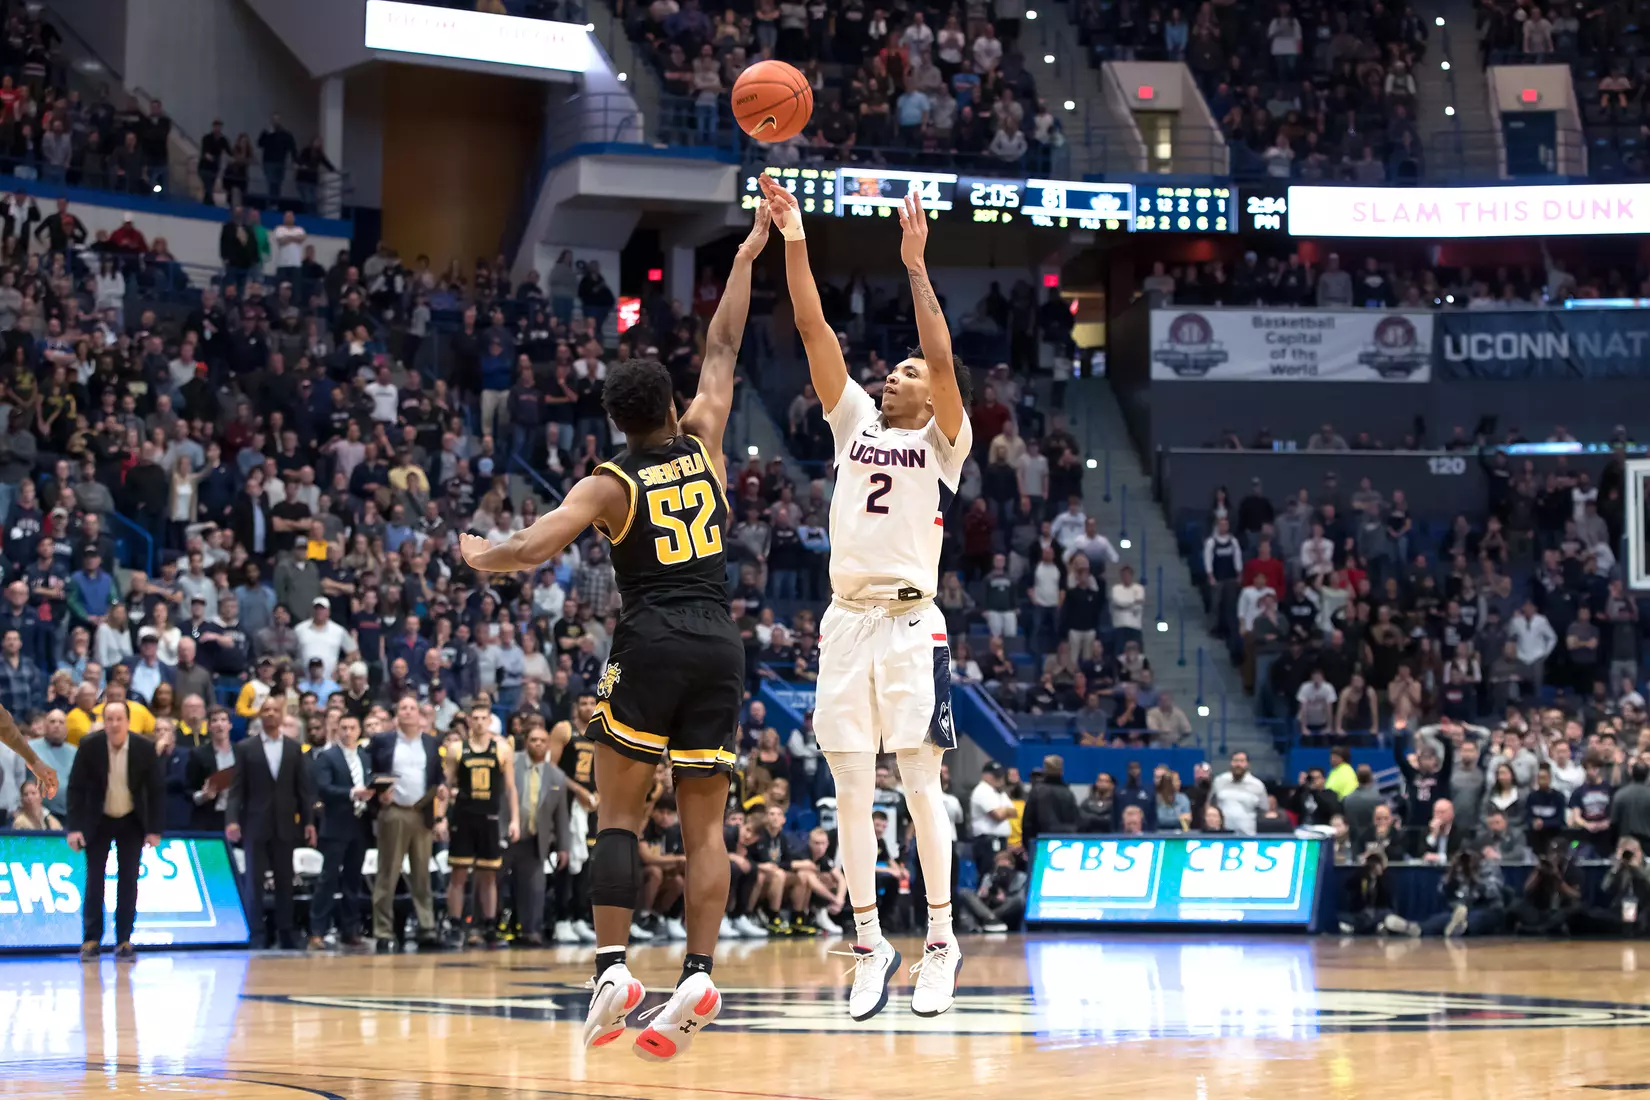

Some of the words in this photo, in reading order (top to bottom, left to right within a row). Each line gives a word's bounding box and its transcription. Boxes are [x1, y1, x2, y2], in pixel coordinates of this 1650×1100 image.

[804, 180, 815, 194] 2
[970, 183, 1019, 207] 2:05
[1042, 187, 1066, 208] 81
[1156, 198, 1173, 212] 12
[1178, 198, 1189, 212] 2
[1196, 198, 1208, 212] 6
[1217, 198, 1225, 213] 1
[1352, 202, 1441, 222] SLAM
[1455, 201, 1528, 221] THIS
[1543, 199, 1633, 220] DUNK
[1159, 215, 1170, 230] 2
[1178, 216, 1190, 230] 0
[1215, 216, 1227, 230] 2
[1252, 316, 1335, 329] Basketball
[1265, 332, 1322, 345] Capital
[1445, 332, 1569, 361] UCONN
[1270, 349, 1287, 361] of
[1292, 349, 1317, 361] the
[1270, 363, 1318, 376] World
[850, 441, 925, 468] UCONN
[1428, 457, 1466, 475] 120
[638, 453, 705, 486] SHERFIELD
[866, 473, 892, 514] 2
[646, 480, 722, 565] 52
[471, 767, 490, 790] 10
[1048, 840, 1138, 871] CBS
[1186, 841, 1278, 871] CBS
